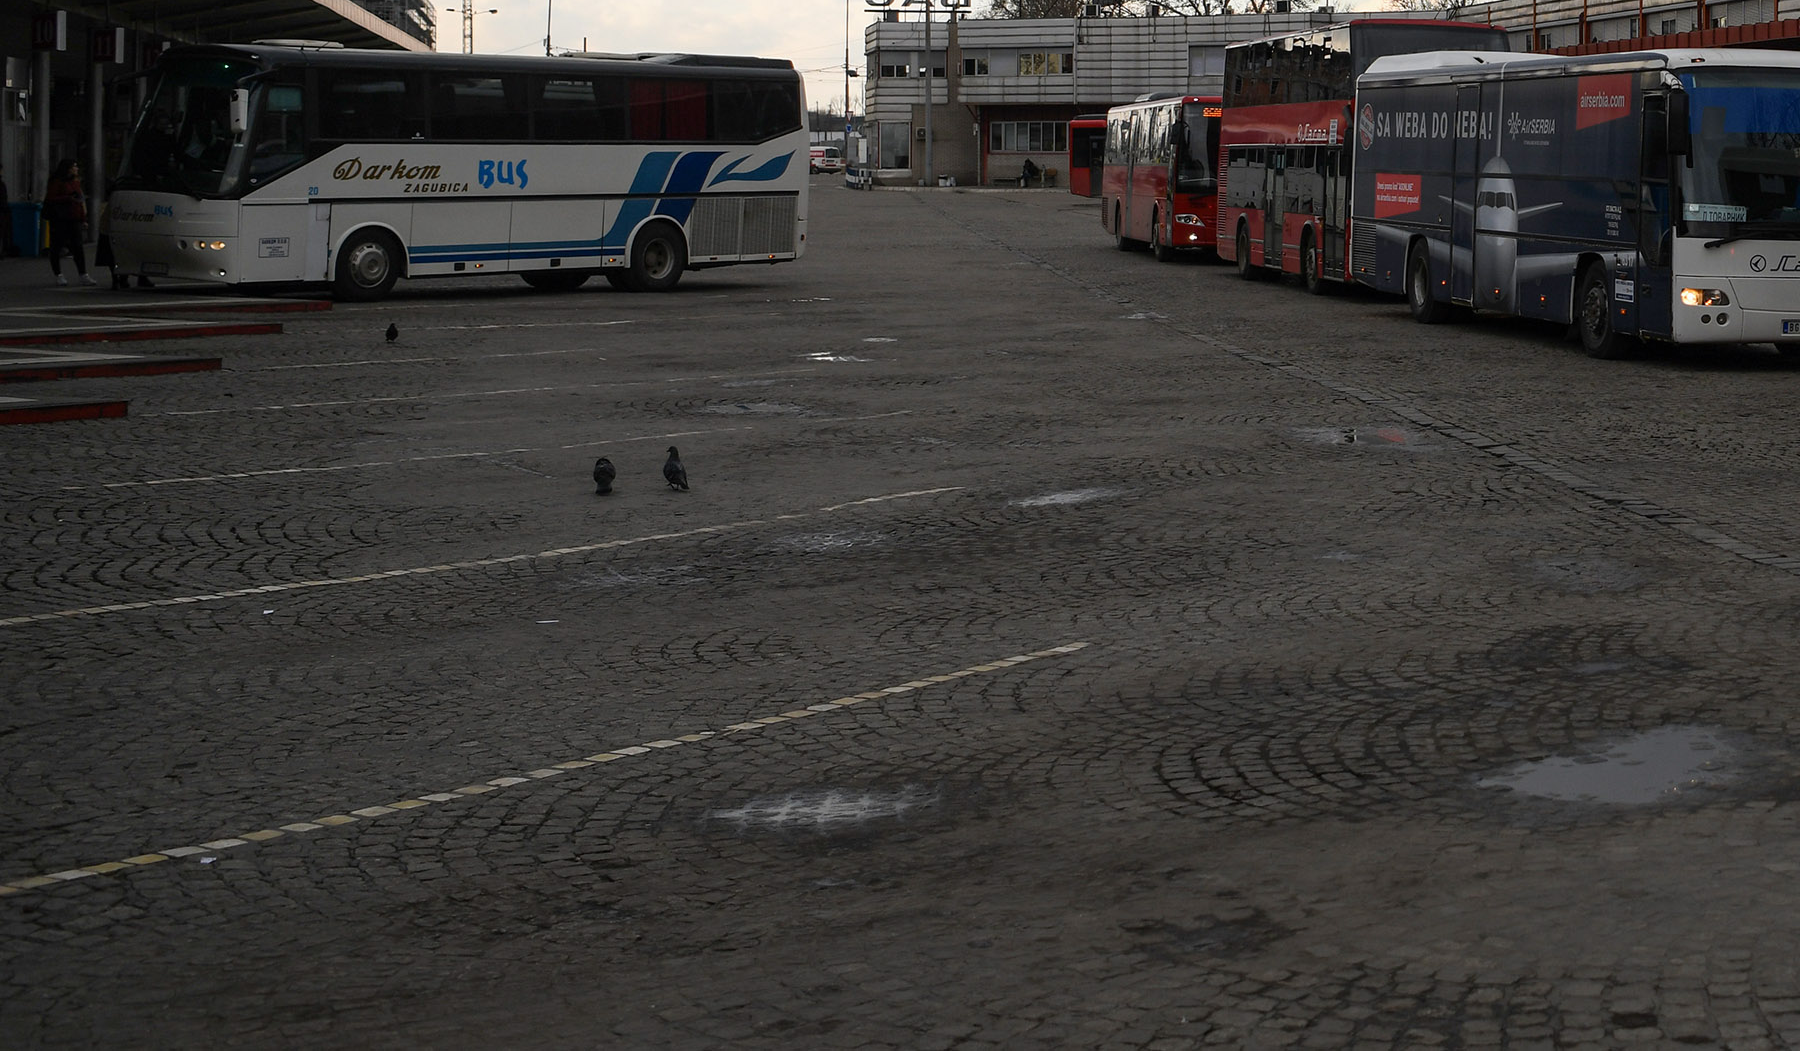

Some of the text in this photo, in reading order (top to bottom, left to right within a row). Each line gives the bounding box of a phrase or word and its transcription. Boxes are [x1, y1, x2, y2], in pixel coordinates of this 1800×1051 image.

[36, 21, 53, 44] 10
[1580, 91, 1625, 108] airserbia.com
[1376, 112, 1391, 138] SA
[1395, 112, 1427, 139] WEBA
[1431, 112, 1449, 139] DO
[333, 157, 529, 189] Darkom BUS
[308, 186, 319, 196] 20
[404, 183, 469, 193] ZAGUBICA
